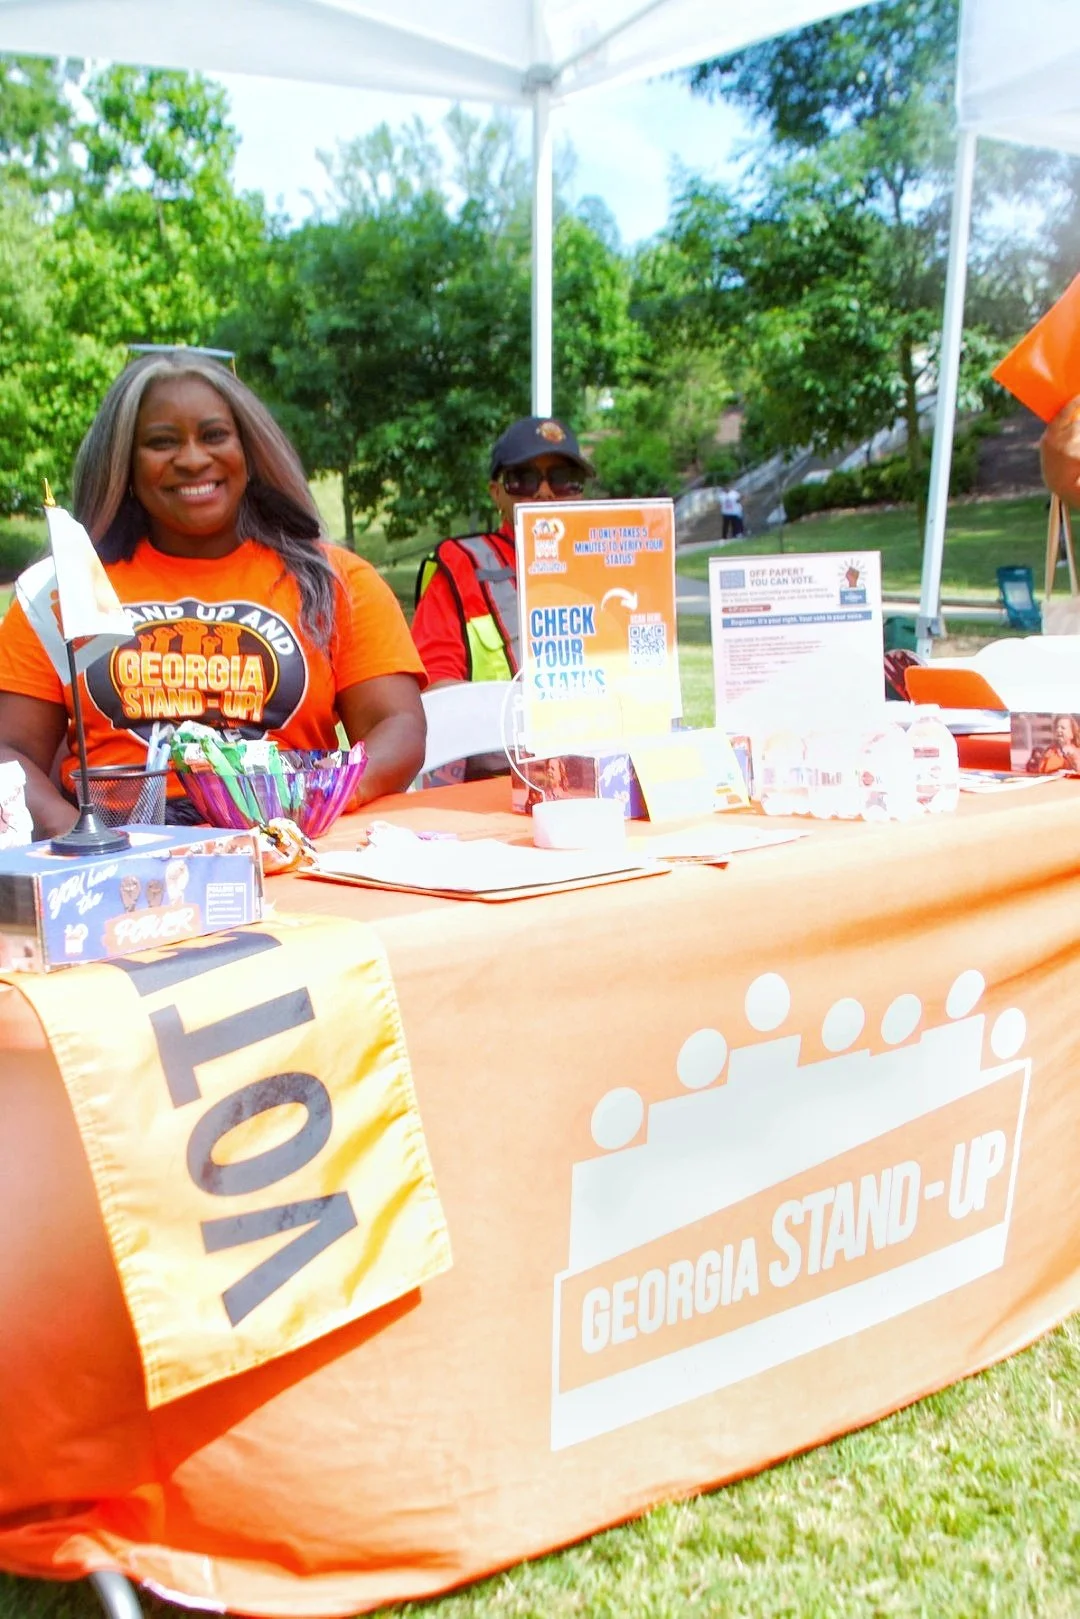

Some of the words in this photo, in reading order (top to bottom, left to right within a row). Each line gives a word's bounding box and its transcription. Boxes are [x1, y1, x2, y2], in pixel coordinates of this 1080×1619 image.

[574, 541, 606, 553] MINUTES
[609, 540, 619, 551] TO
[620, 539, 643, 551] VERIFY
[645, 538, 664, 550] YOUR
[590, 528, 597, 540] IT
[599, 527, 617, 539] ONLY
[620, 526, 641, 538] TAKES
[642, 526, 648, 537] 5
[749, 569, 766, 578] OFF
[769, 567, 804, 577] PAPER?
[750, 578, 768, 587] YOU
[770, 576, 789, 586] CAN
[196, 604, 236, 622] UP
[238, 609, 296, 657] AND
[530, 606, 595, 638] CHECK
[531, 638, 584, 669] YOUR
[117, 650, 264, 692] GEORGIA
[113, 906, 195, 946] POWER
[580, 1236, 760, 1355] GEORGIA
